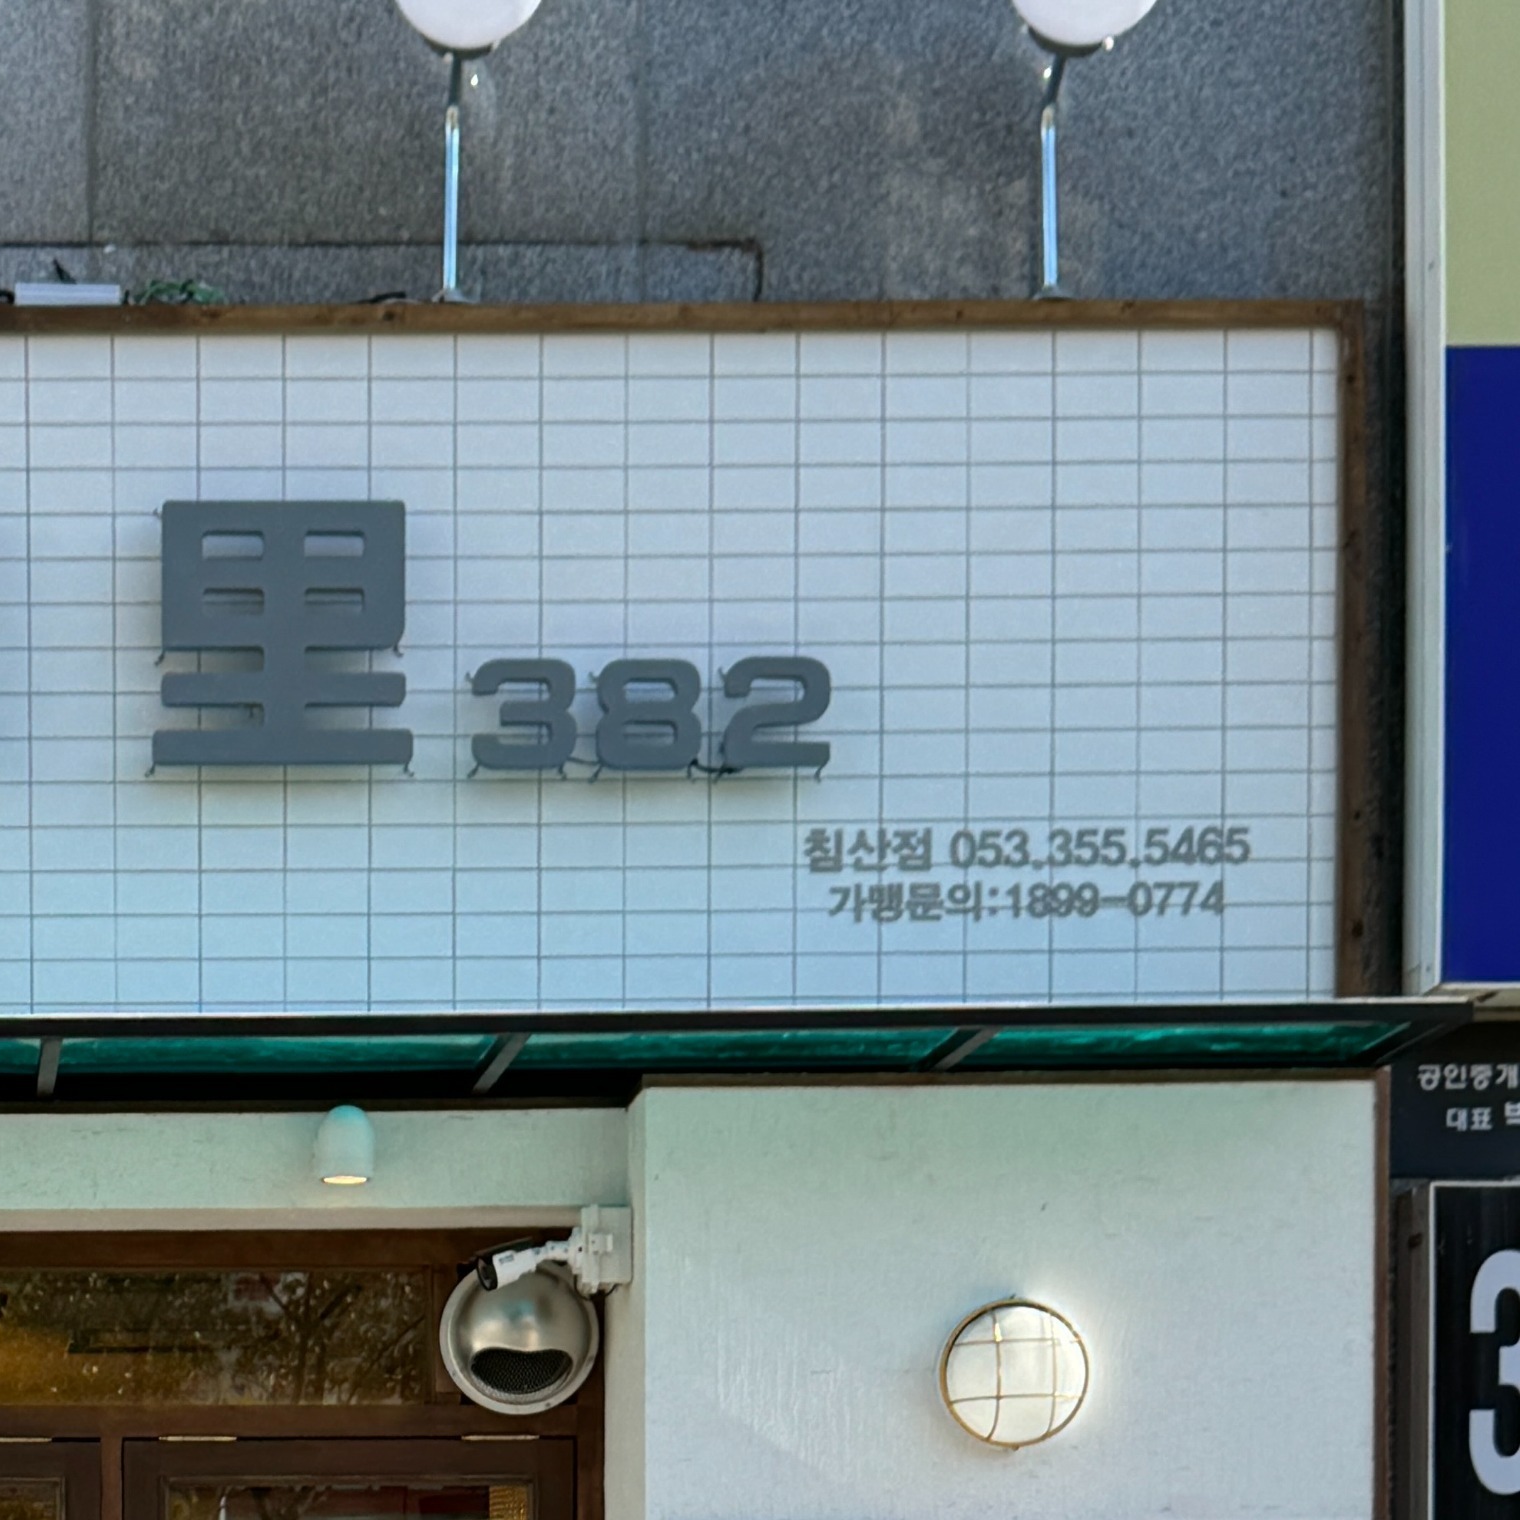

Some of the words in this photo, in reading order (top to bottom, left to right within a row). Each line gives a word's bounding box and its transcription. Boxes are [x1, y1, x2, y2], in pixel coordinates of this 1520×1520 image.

[472, 655, 831, 768] 382
[804, 827, 932, 872] 침산점
[949, 827, 1250, 871] 053.355.5465
[1446, 1106, 1493, 1132] 대표
